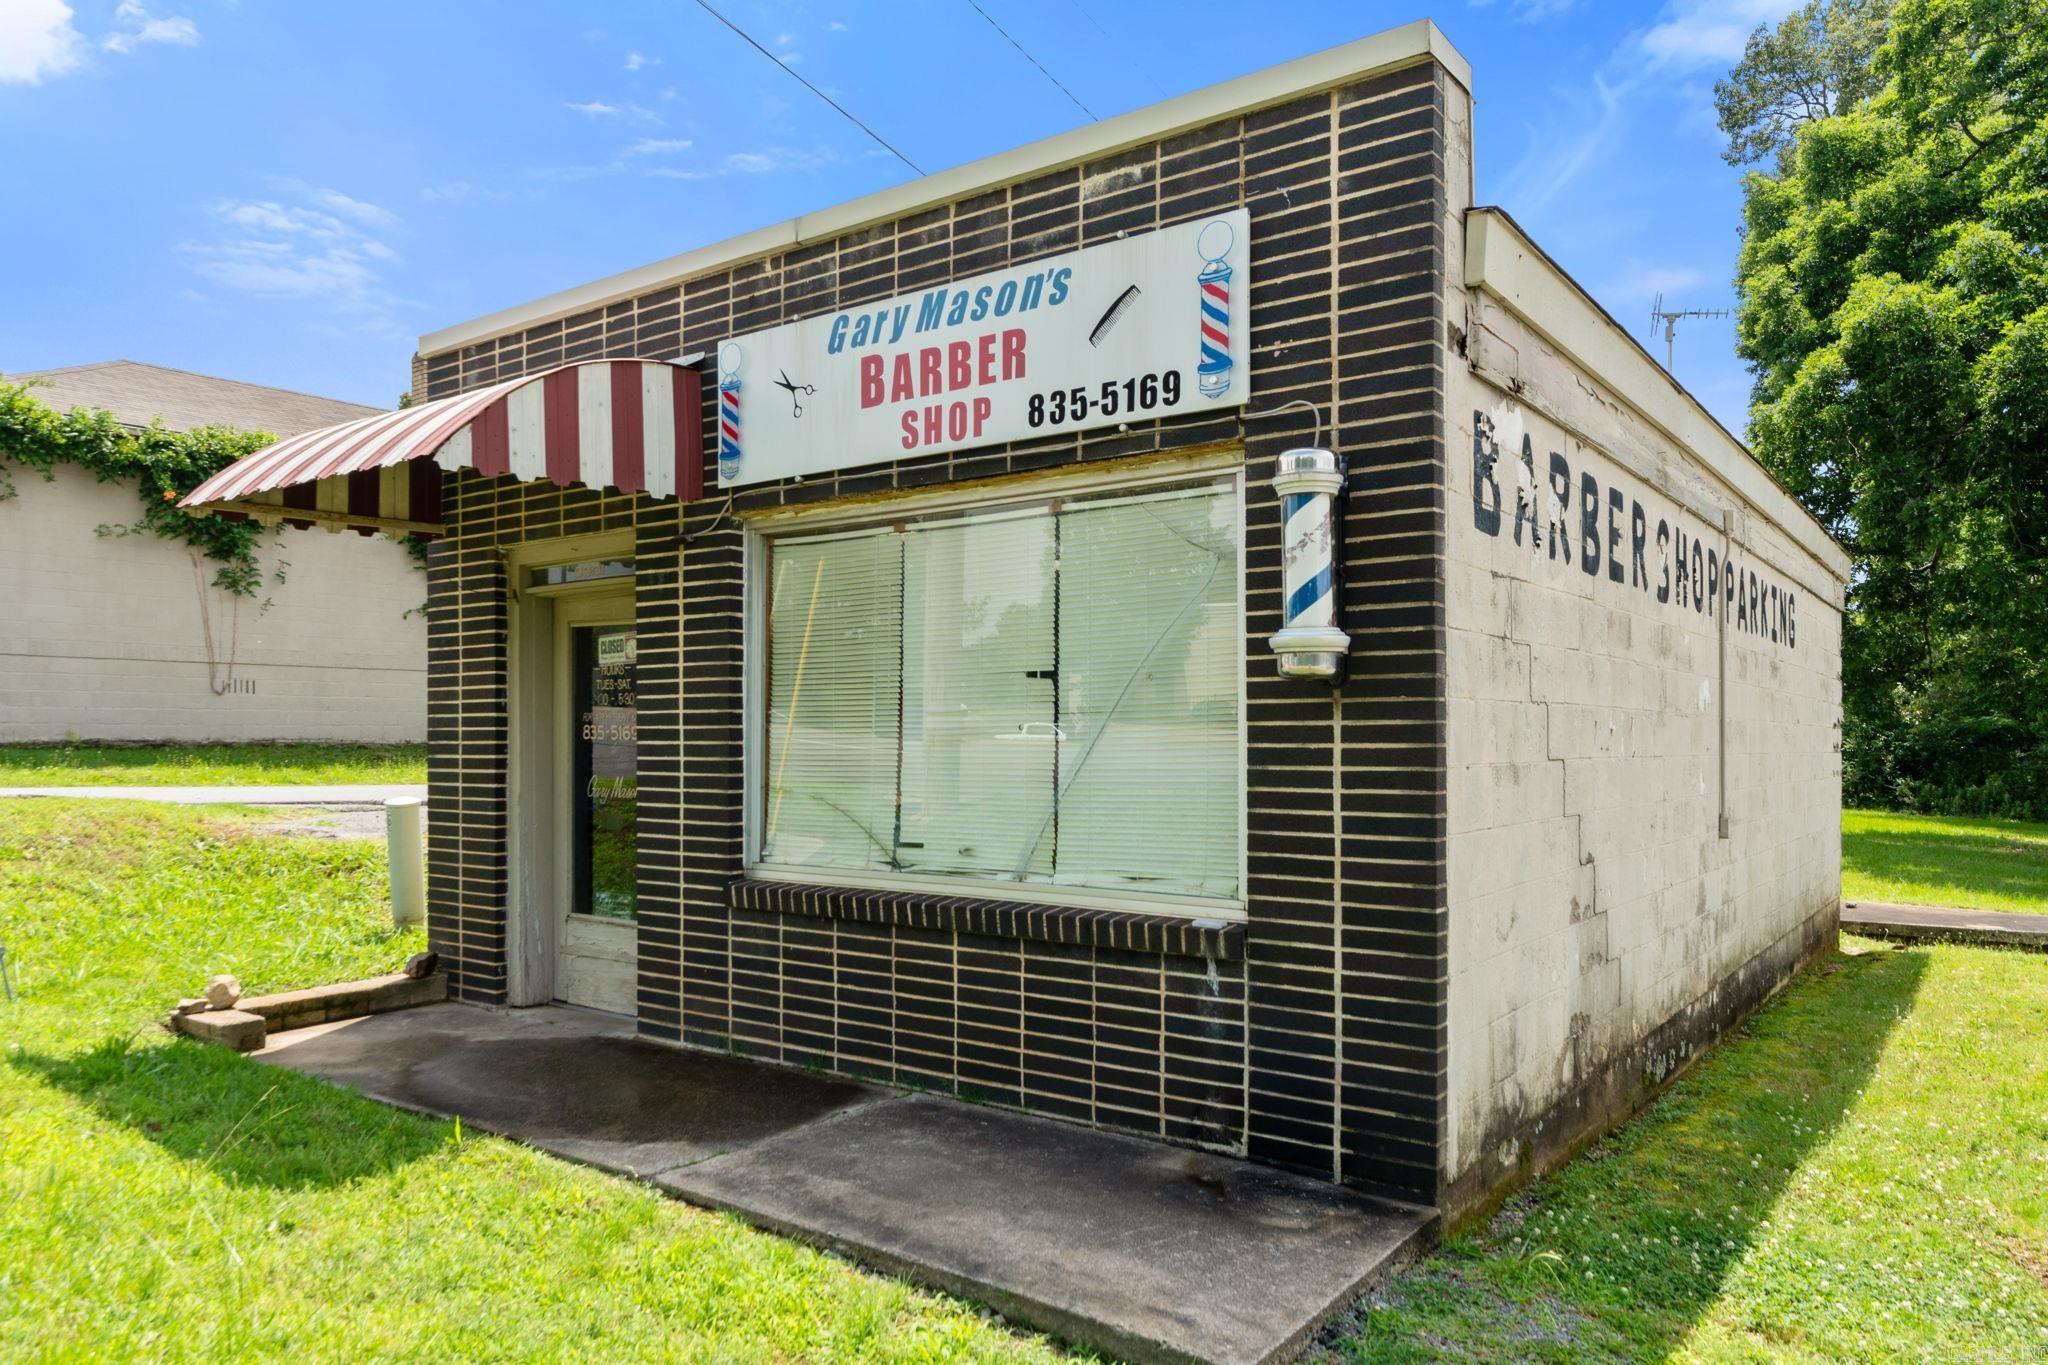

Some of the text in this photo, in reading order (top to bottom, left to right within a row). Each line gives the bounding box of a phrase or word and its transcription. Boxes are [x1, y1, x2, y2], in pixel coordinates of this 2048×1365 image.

[827, 266, 1072, 355] Gary Mason's
[860, 328, 1027, 409] BARBER
[1028, 369, 1182, 428] 835-5169
[901, 397, 992, 450] SHOP
[1473, 409, 1796, 649] BARBER SHOP PARKING
[600, 638, 625, 655] CLOSED
